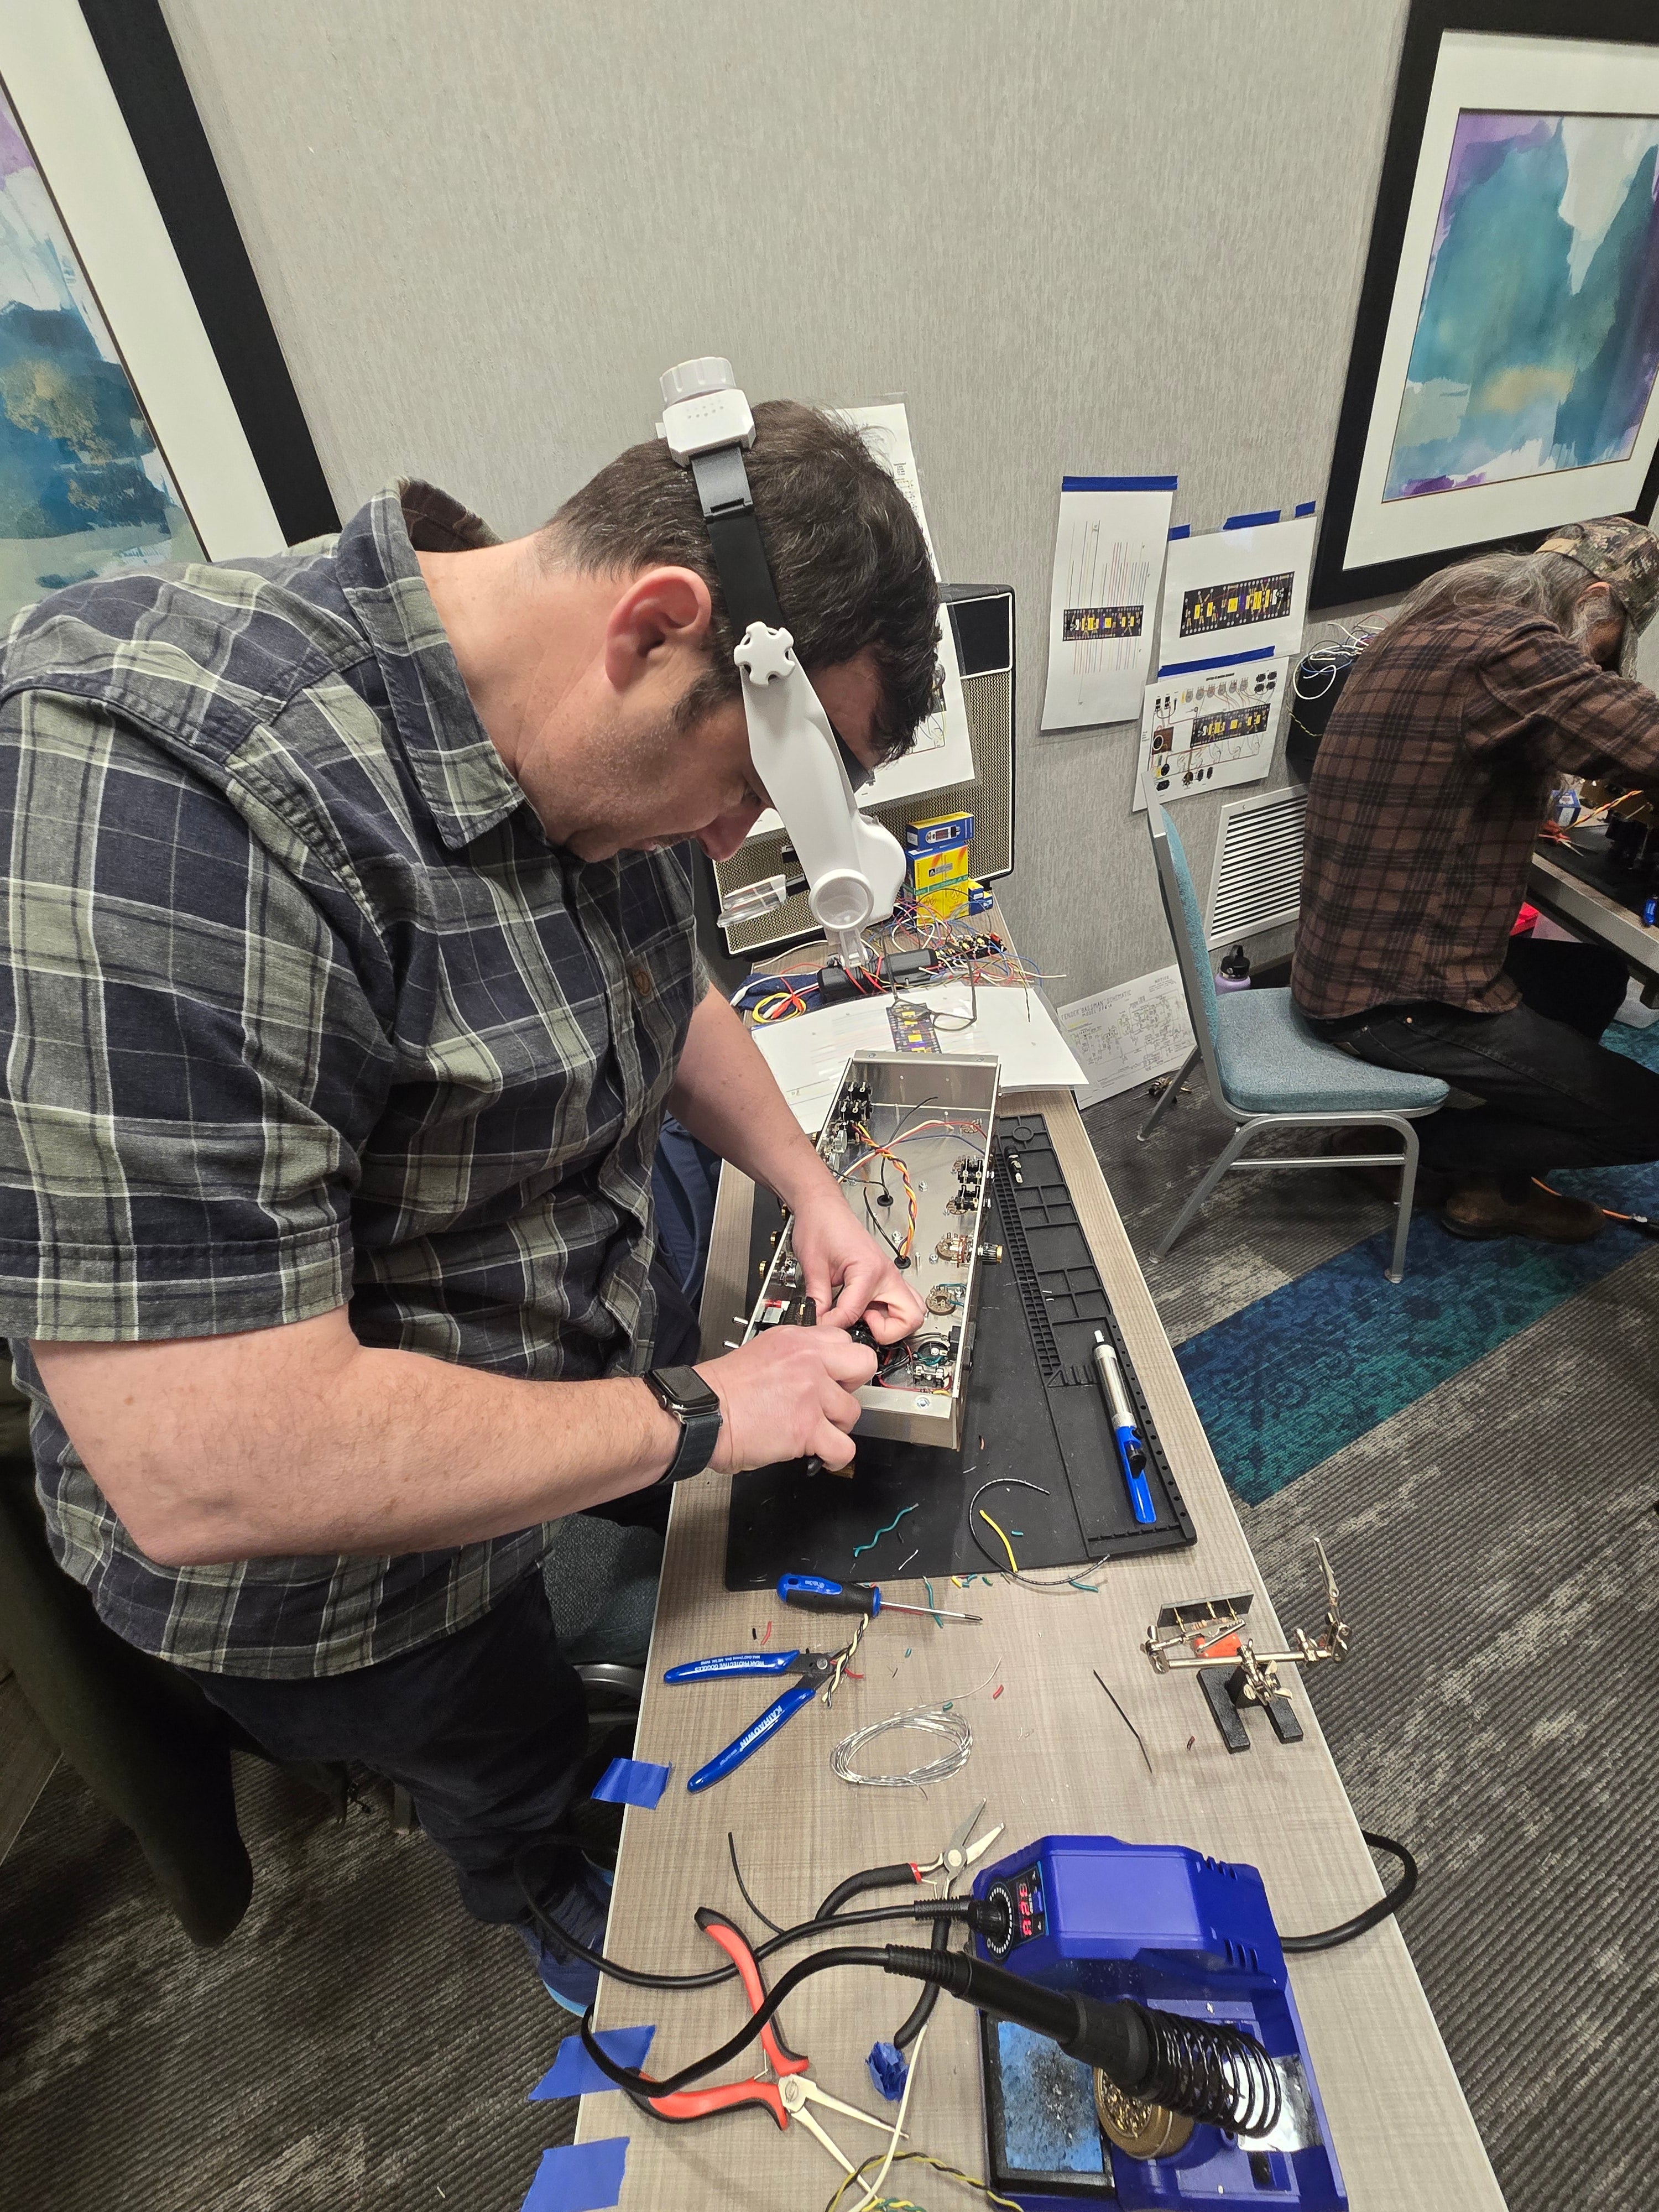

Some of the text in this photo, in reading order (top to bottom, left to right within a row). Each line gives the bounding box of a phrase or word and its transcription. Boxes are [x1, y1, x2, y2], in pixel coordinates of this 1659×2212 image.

[1062, 1009, 1079, 1020] FENDER
[1107, 989, 1131, 1004] SCHEMATIC
[740, 1705, 782, 1749] KAIHAOWIN
